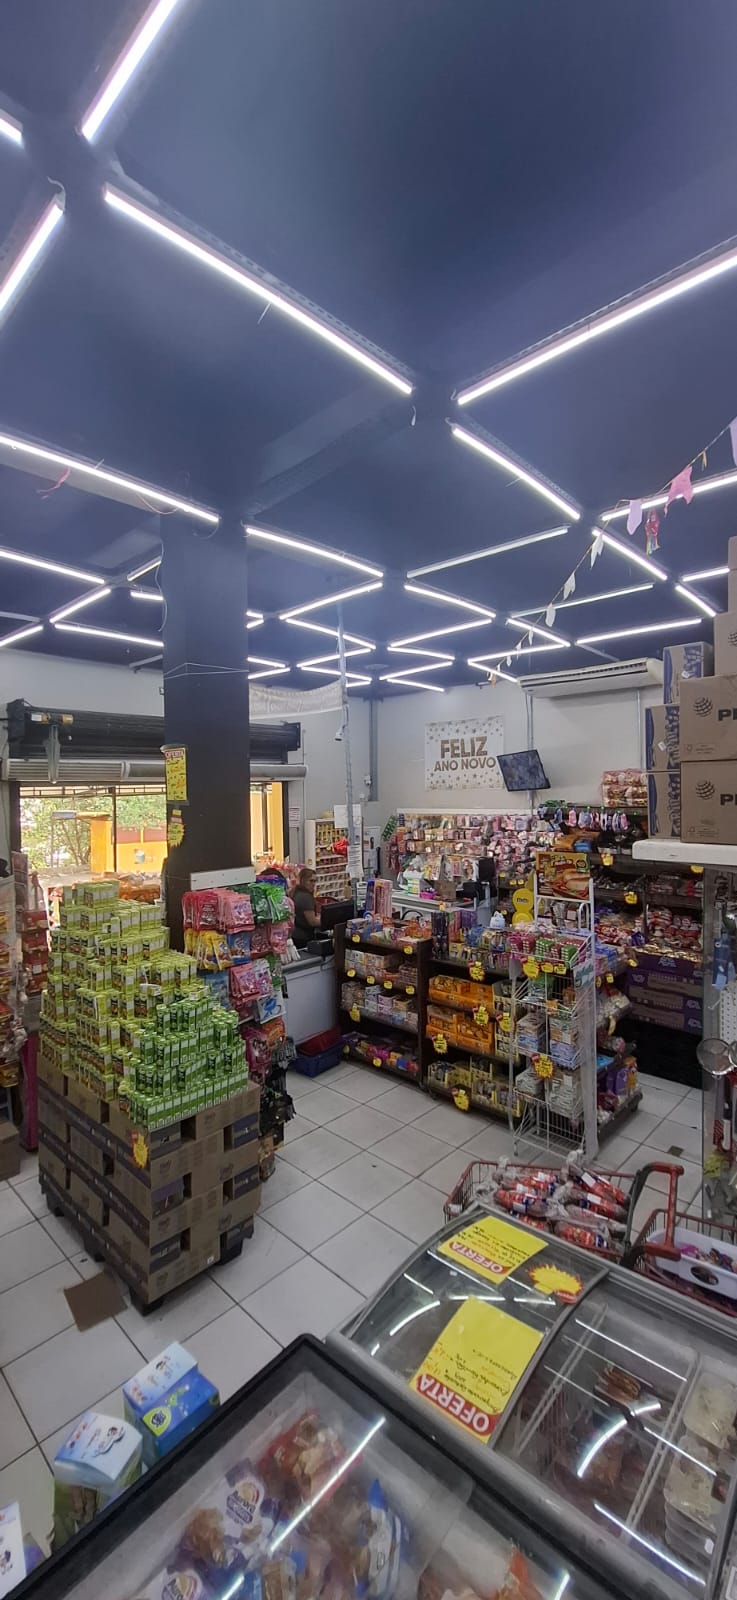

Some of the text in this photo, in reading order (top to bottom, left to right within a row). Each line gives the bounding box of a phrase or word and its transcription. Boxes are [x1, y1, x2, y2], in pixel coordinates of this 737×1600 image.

[440, 736, 488, 759] FELIZ
[434, 757, 496, 772] ANO NOVO
[451, 1242, 504, 1274] OFERTA
[418, 1375, 490, 1433] OFERTA
